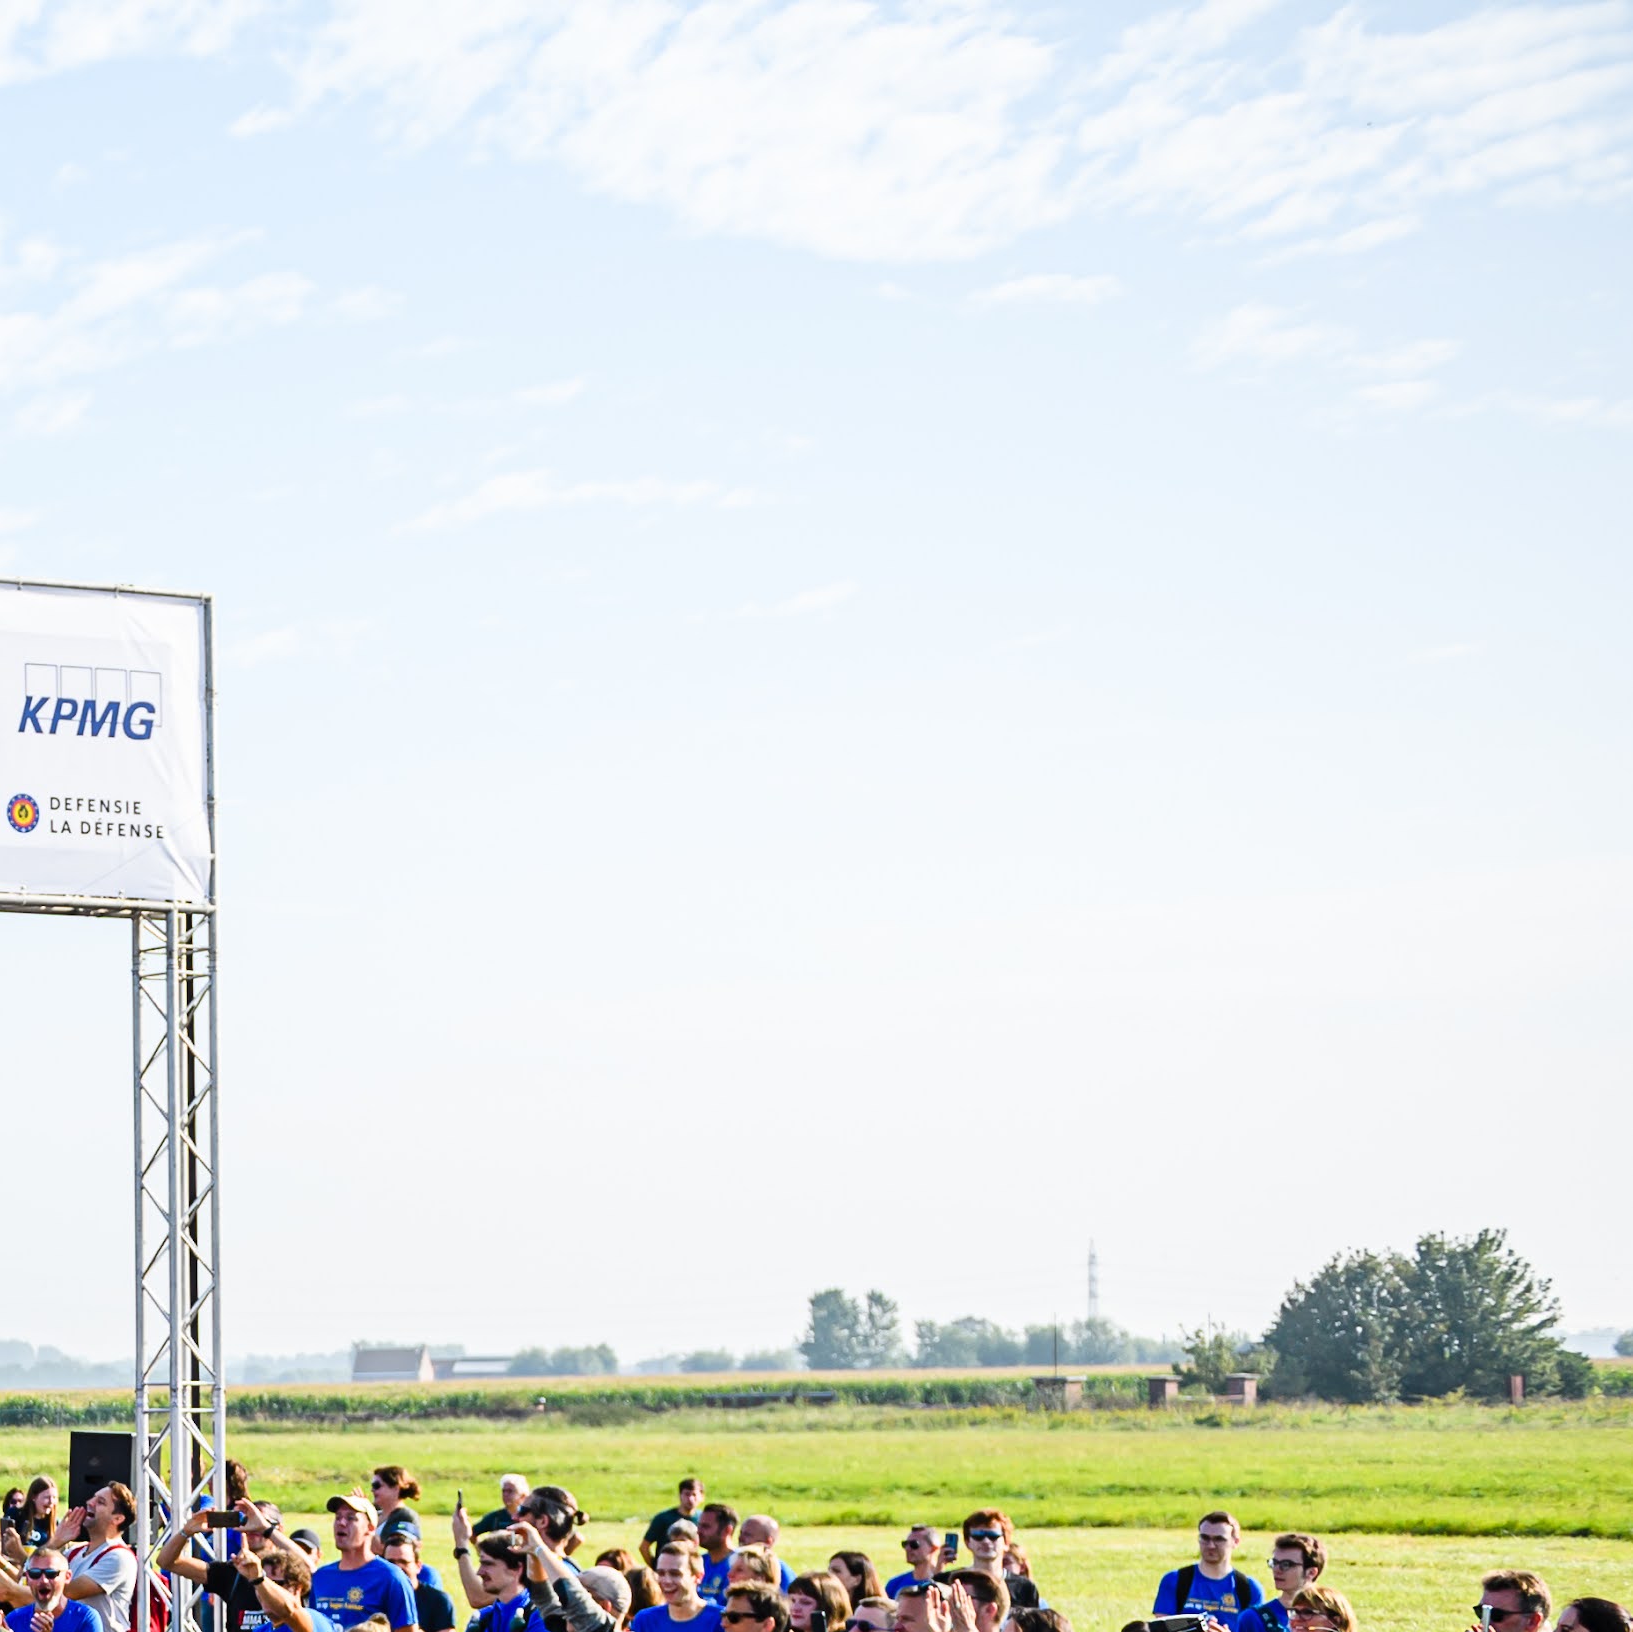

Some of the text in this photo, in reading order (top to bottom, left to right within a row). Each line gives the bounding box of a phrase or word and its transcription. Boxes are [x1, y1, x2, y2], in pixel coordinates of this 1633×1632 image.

[18, 695, 156, 741] KPMG
[50, 796, 141, 816] DEFENSIE
[50, 819, 165, 839] LA DÉFENSE
